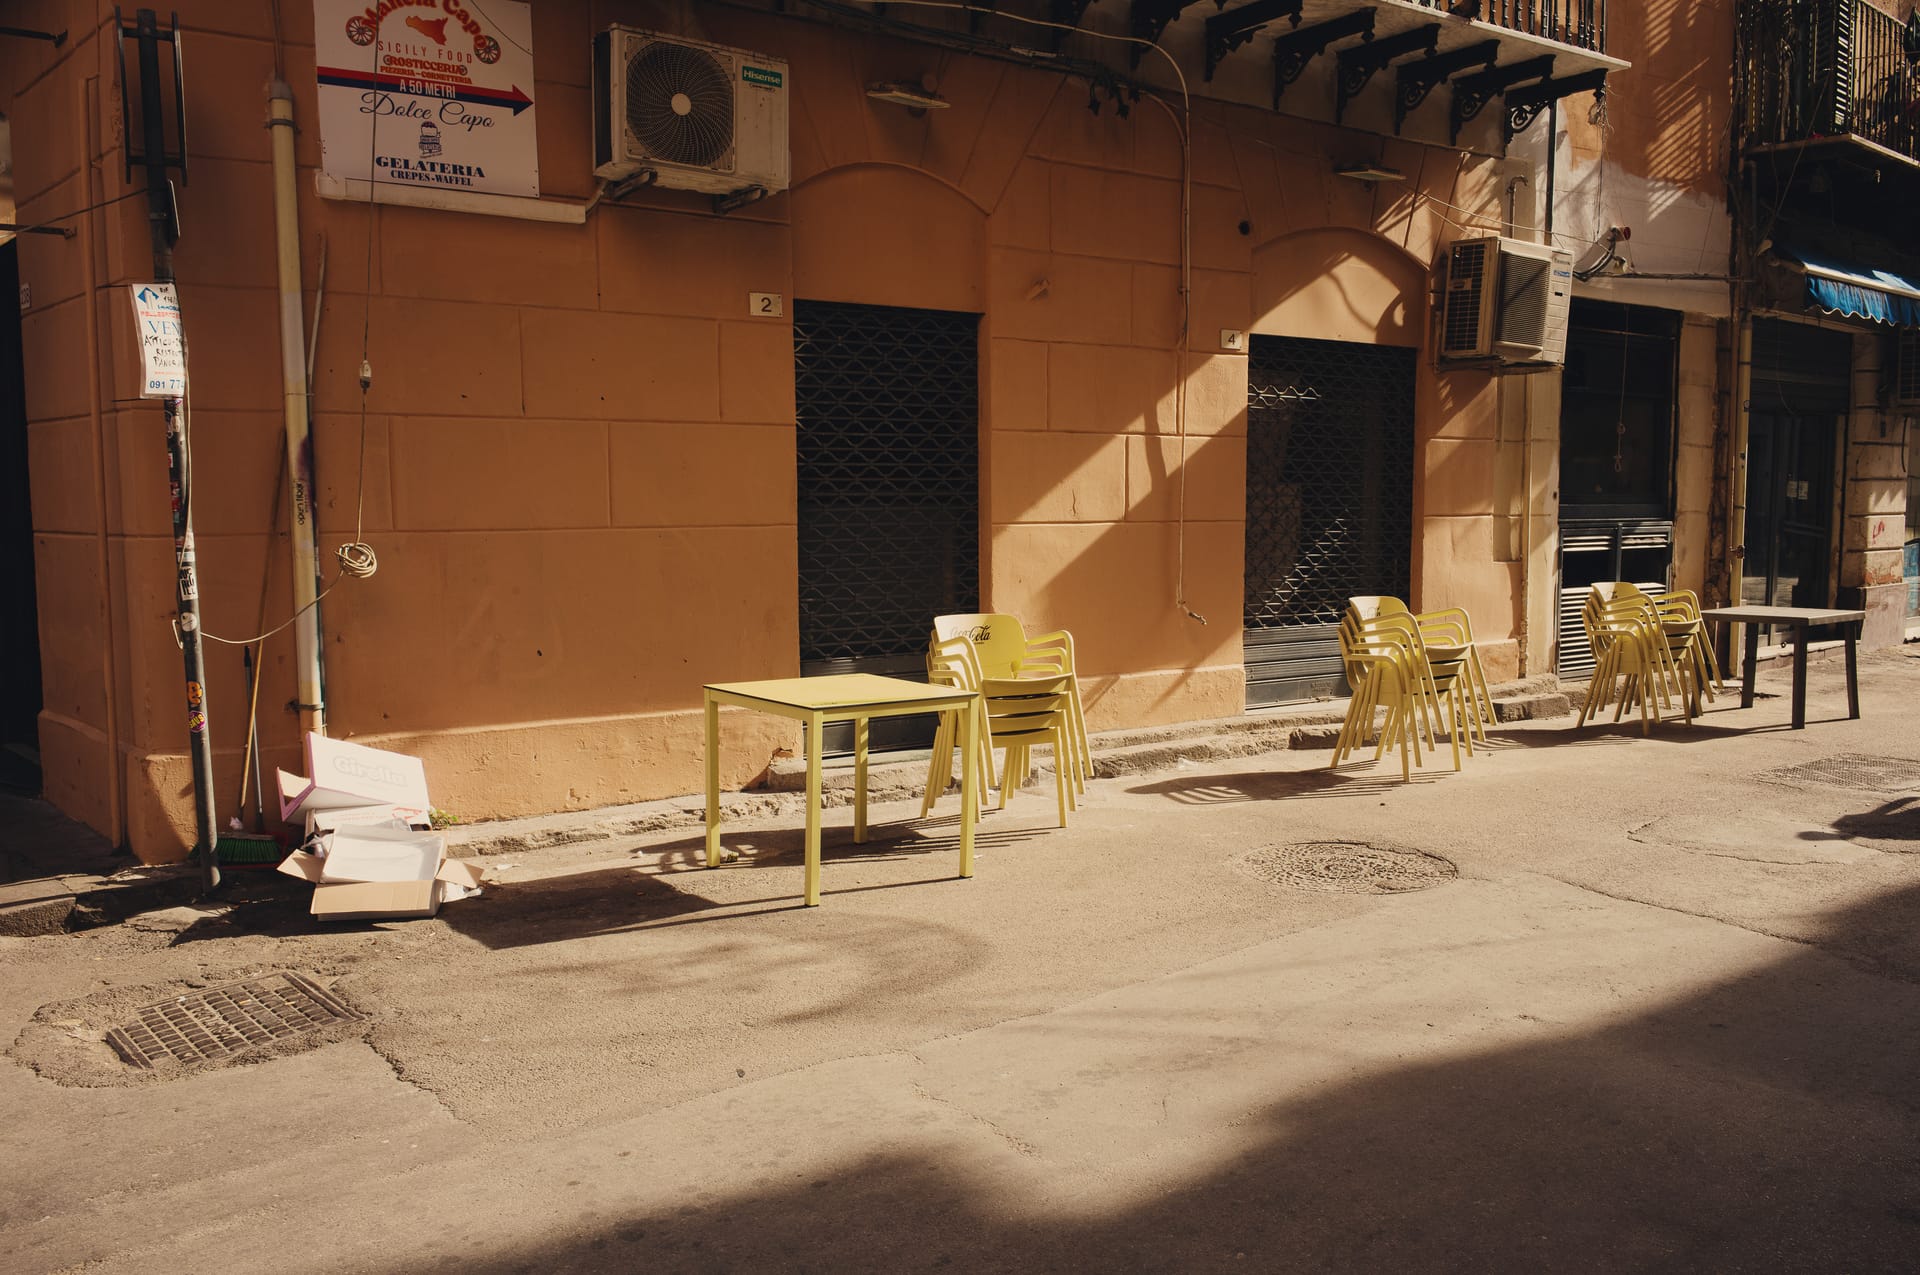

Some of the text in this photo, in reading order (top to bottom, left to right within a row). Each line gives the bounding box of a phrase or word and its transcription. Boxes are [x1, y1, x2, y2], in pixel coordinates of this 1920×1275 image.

[442, 0, 488, 49] Capo
[378, 41, 472, 64] SICILY FOOD
[389, 56, 464, 74] ROSTICCERIA
[744, 70, 780, 83] Hisense
[399, 79, 456, 99] A 50 METRI
[359, 91, 495, 132] Dolce Capo
[375, 156, 486, 178] GELATERIA
[761, 296, 772, 313] 2
[1227, 333, 1236, 345] 4
[149, 380, 166, 389] 091
